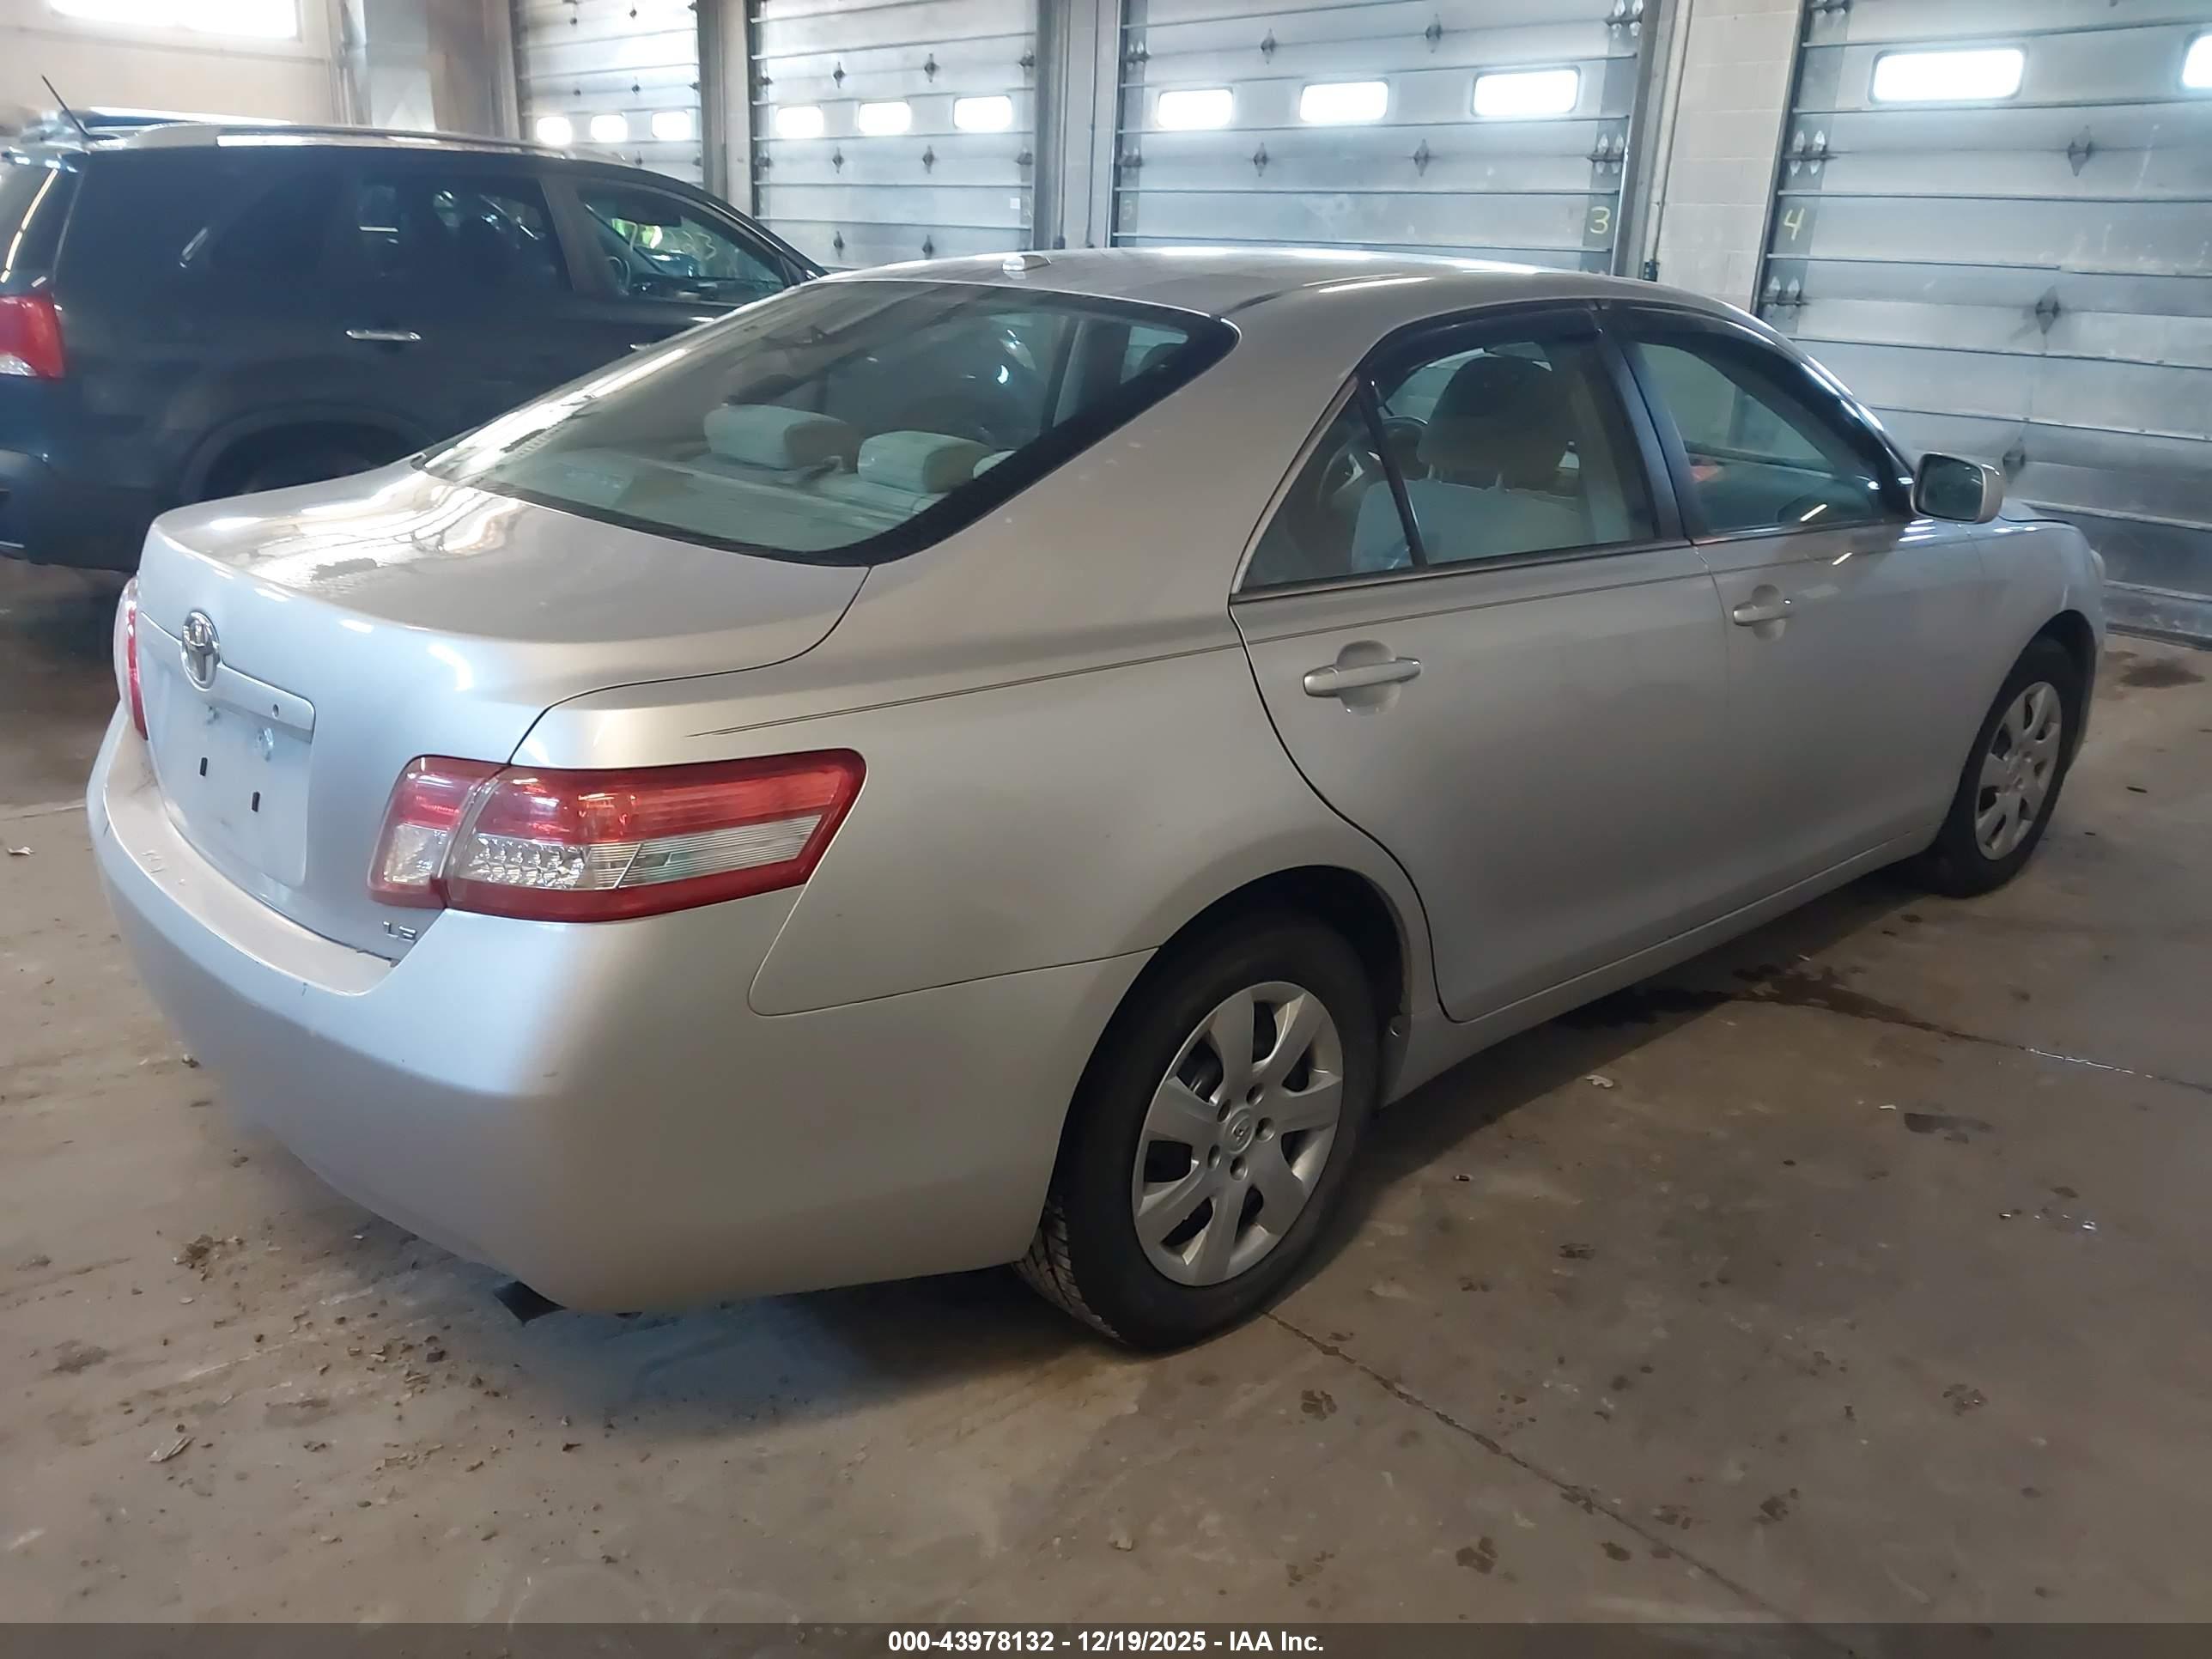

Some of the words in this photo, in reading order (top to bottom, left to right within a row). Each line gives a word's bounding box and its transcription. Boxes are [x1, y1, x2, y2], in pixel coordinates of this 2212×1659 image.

[1589, 205, 1611, 234] 3
[1783, 207, 1806, 241] 4
[382, 921, 417, 942] LE
